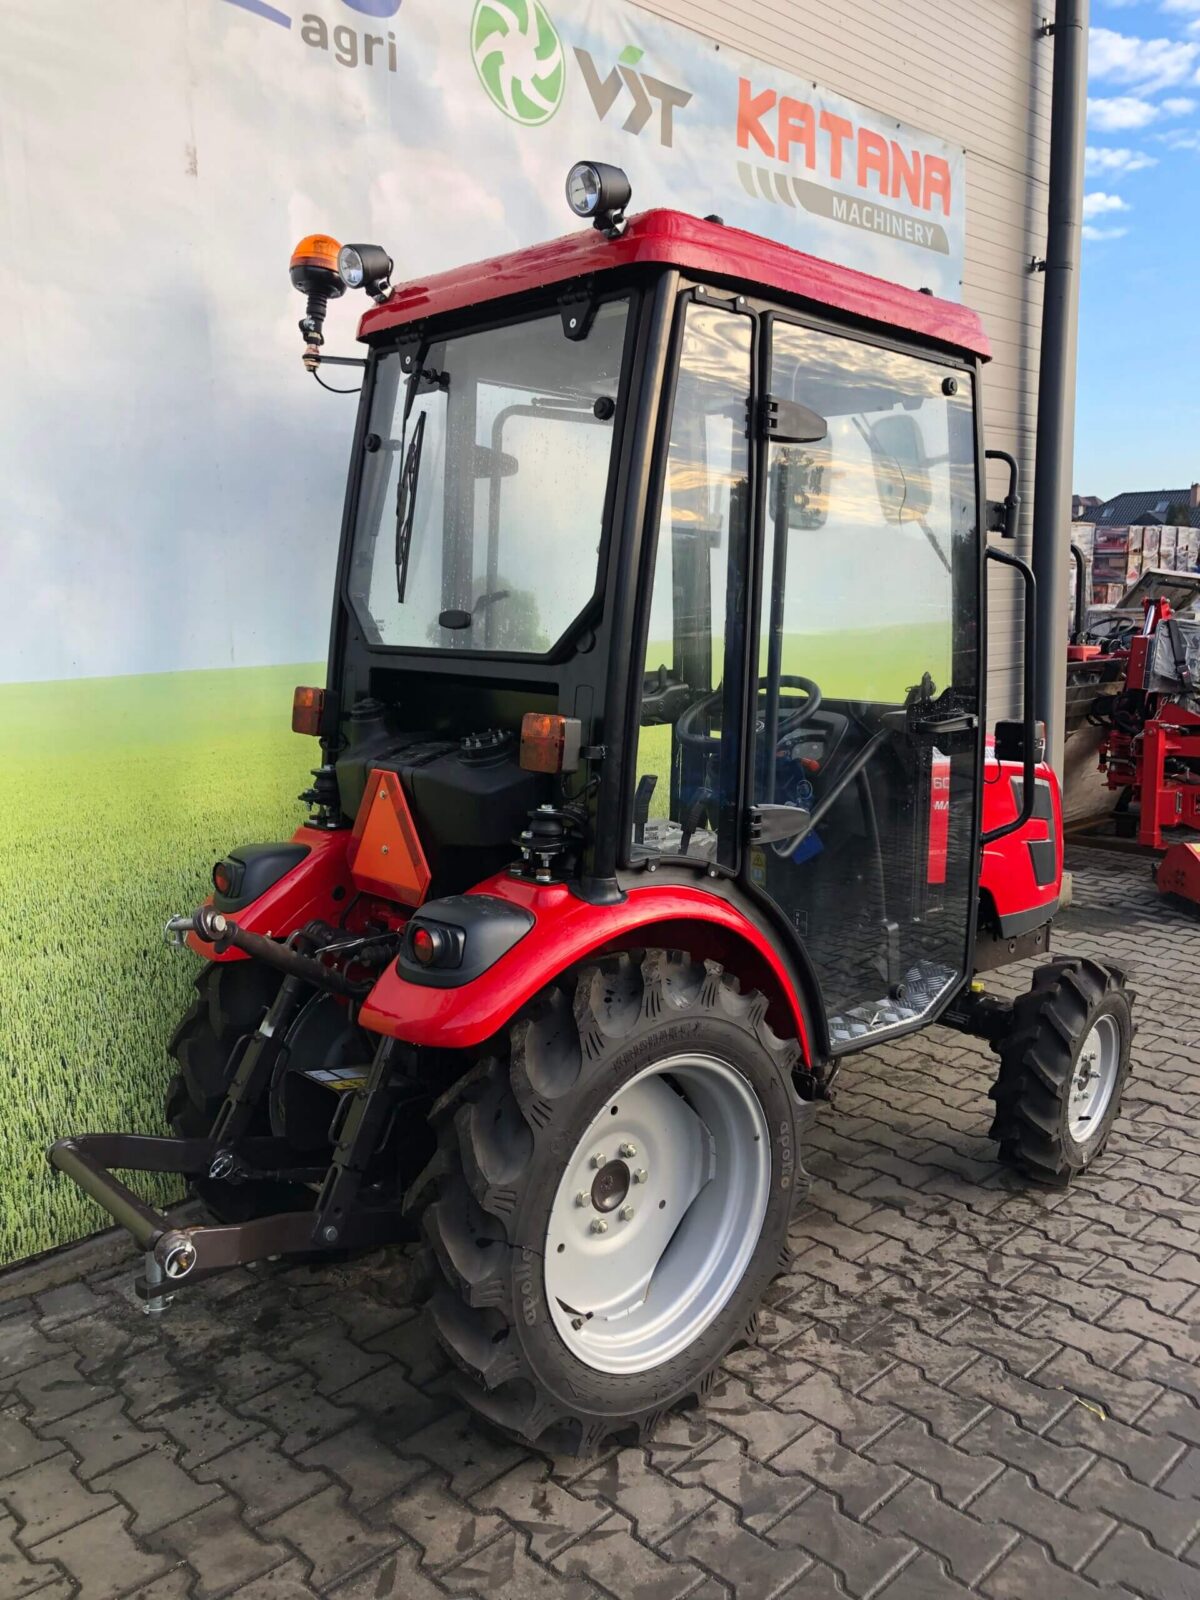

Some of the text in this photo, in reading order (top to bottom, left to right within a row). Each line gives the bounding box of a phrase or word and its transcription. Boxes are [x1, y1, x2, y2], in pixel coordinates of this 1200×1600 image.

[301, 13, 397, 73] agri
[736, 77, 950, 217] KATANA
[832, 197, 935, 246] MACHINERY
